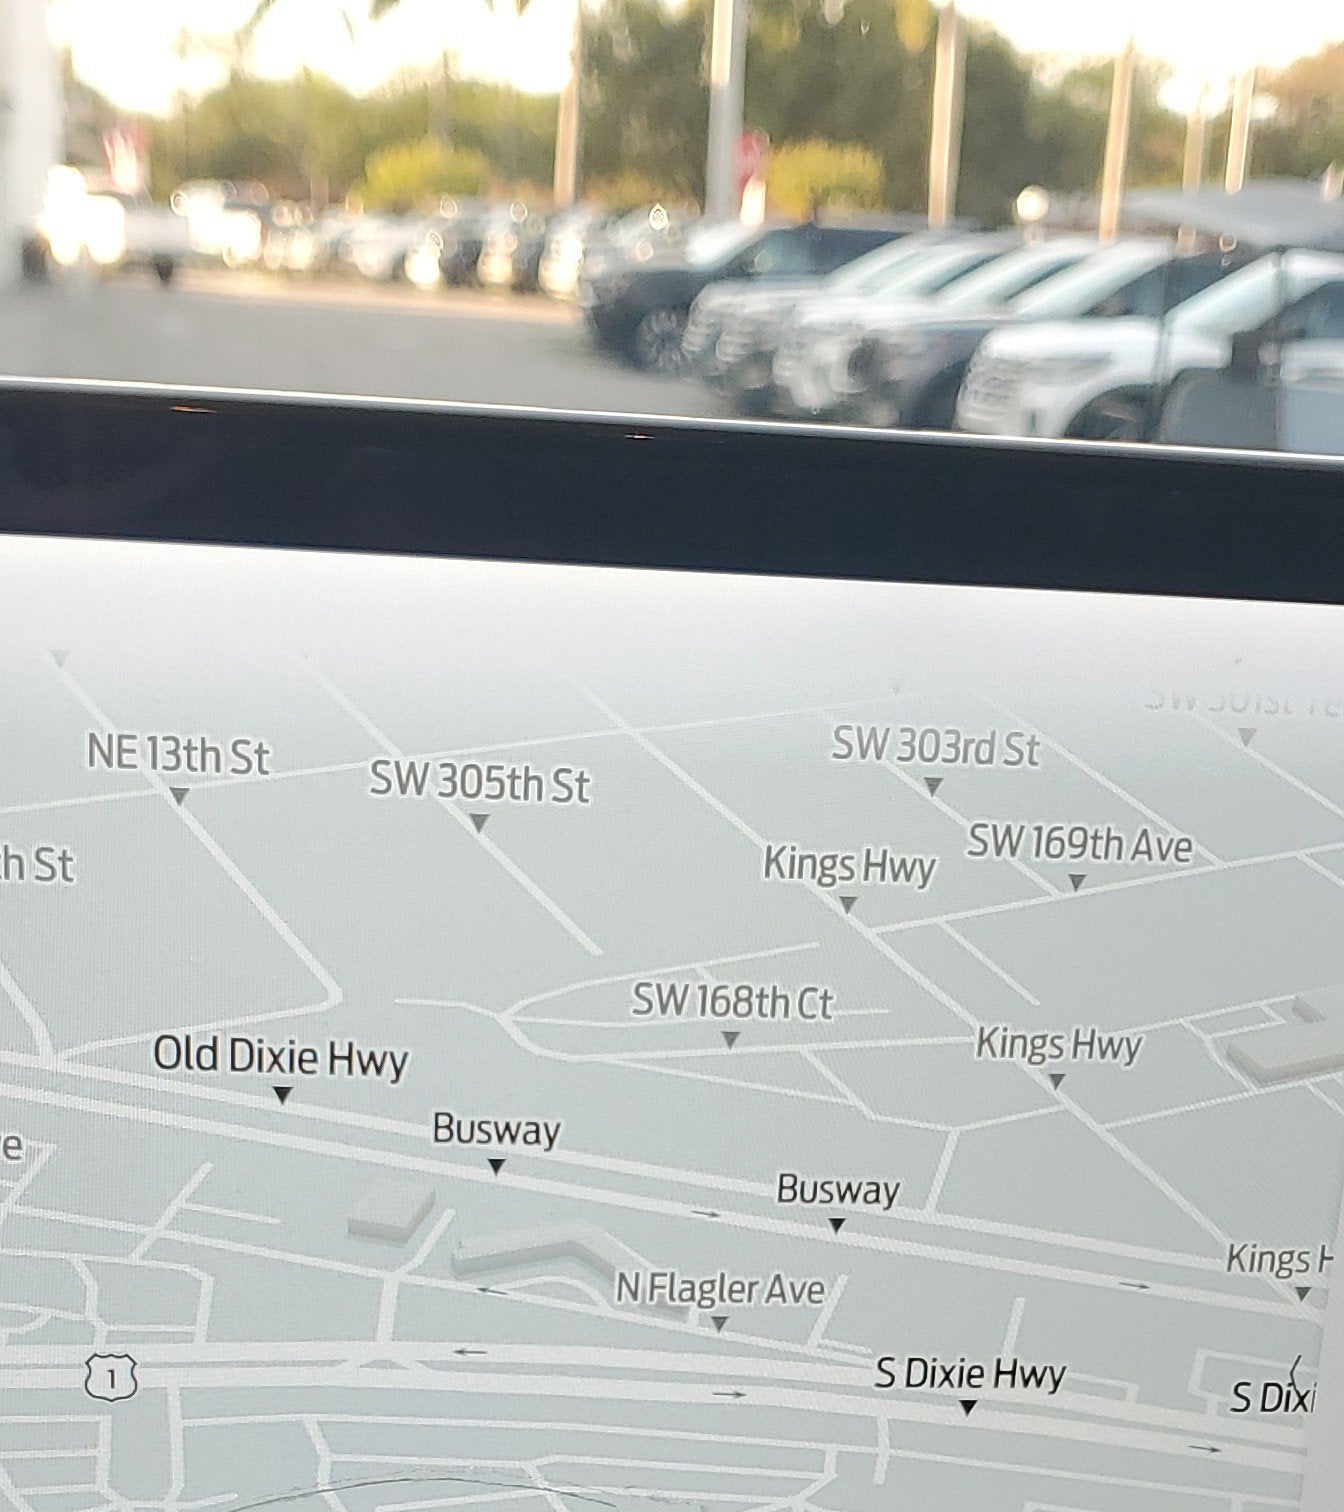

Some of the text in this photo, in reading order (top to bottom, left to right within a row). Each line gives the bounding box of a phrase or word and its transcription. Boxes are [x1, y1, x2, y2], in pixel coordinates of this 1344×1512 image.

[87, 732, 270, 775] NE 13th St
[831, 725, 1041, 767] SW 303rd St
[370, 759, 590, 803] SW 305th St
[967, 824, 1194, 864] SW 169th Ave
[35, 847, 74, 883] St
[764, 845, 937, 889] Kings Hwy
[632, 981, 834, 1020] SW 168th Ct
[154, 1034, 408, 1083] Old Dixie Hwy
[976, 1025, 1142, 1067] Kings Hwy
[433, 1112, 561, 1150] Busway
[777, 1173, 900, 1210] Busway
[1227, 1243, 1310, 1279] Kings
[617, 1273, 825, 1308] N Flagler Ave
[107, 1367, 116, 1389] 1
[876, 1358, 1067, 1394] S Dixie Hwy
[1230, 1381, 1252, 1412] S
